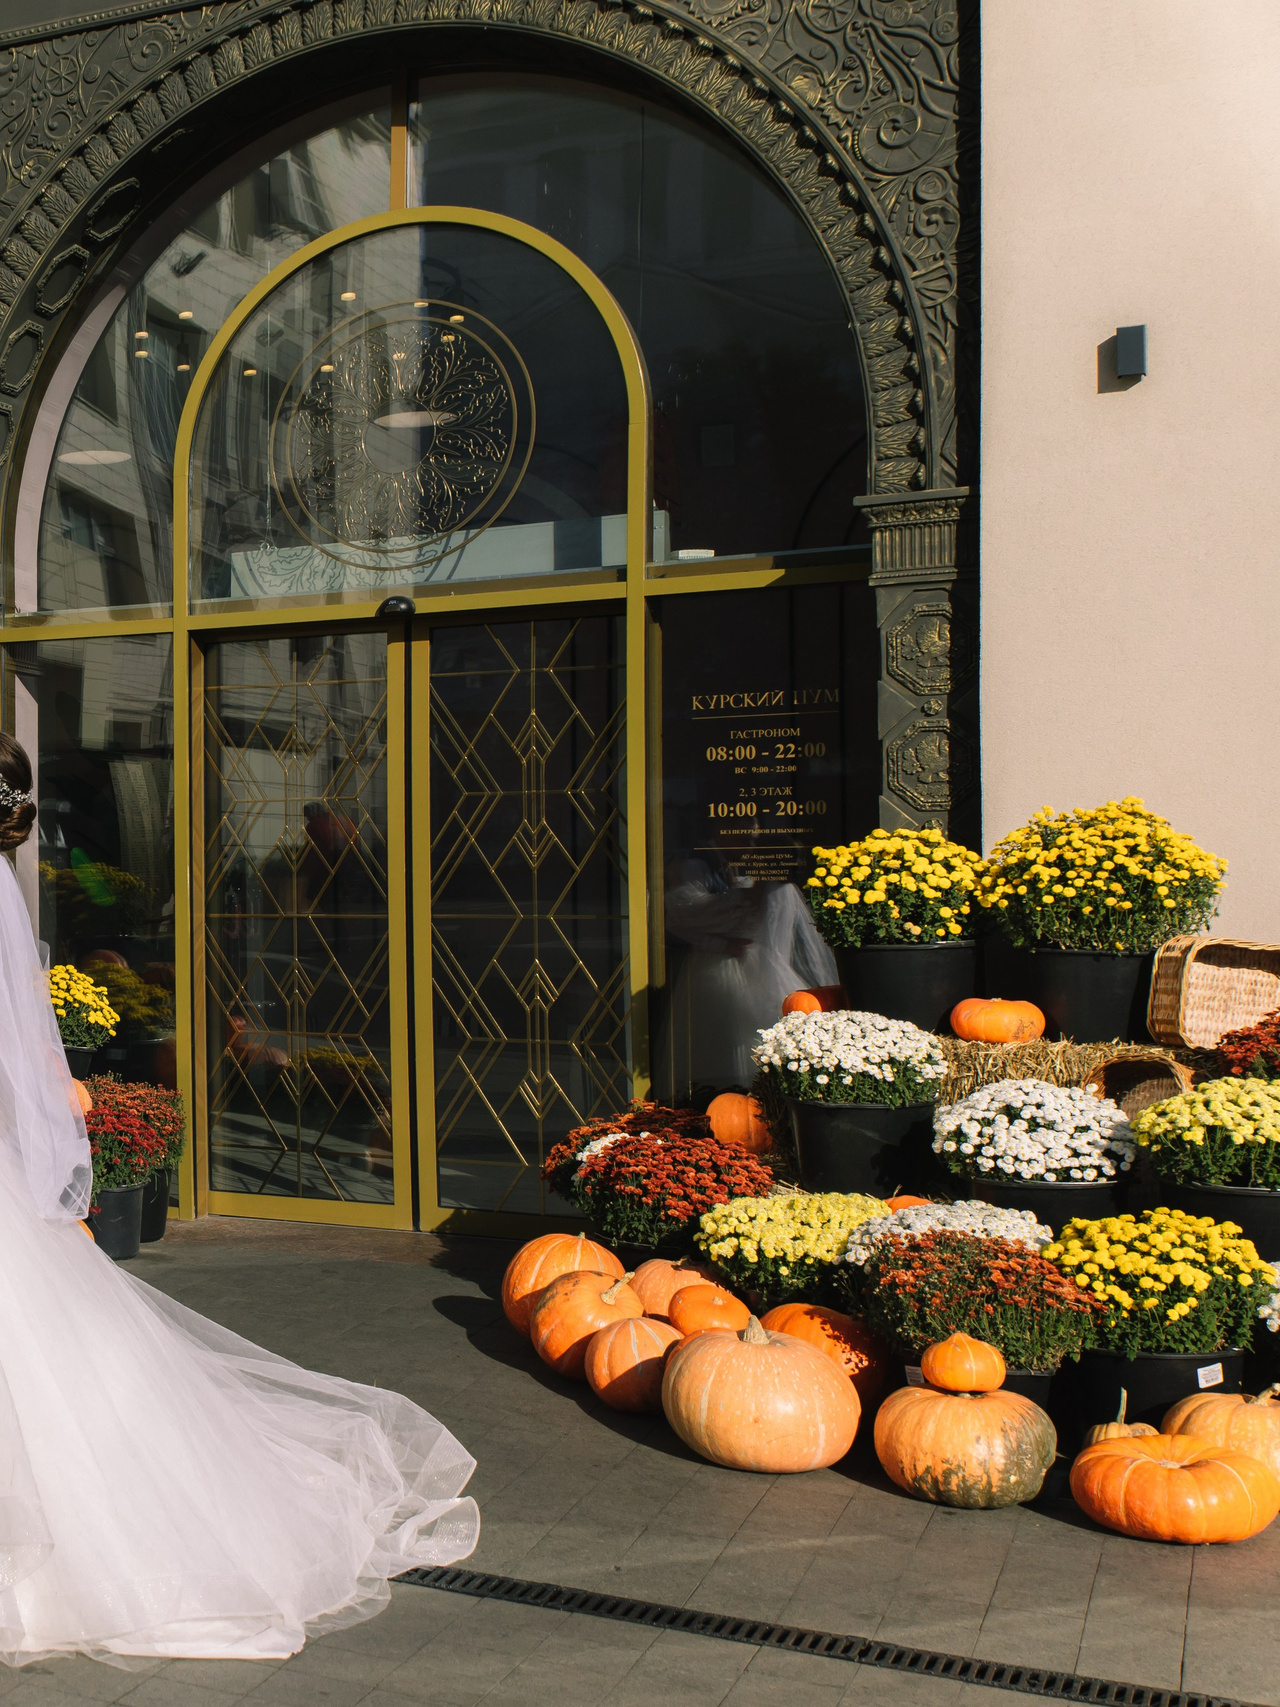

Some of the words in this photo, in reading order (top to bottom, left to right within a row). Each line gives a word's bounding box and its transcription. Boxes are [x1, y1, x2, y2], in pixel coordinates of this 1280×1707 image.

[691, 689, 785, 711] КУРСКИЙ
[793, 688, 840, 705] ЦУМ
[730, 727, 801, 739] ГАСТРОНОМ
[706, 744, 757, 762] 08:00
[774, 742, 827, 759] 22:00
[734, 766, 747, 774] ВС
[775, 765, 797, 773] 22:00
[750, 787, 757, 796] 3
[759, 786, 794, 796] ЭТАЖ
[707, 801, 757, 817] 10:00
[775, 800, 827, 816] 20:00
